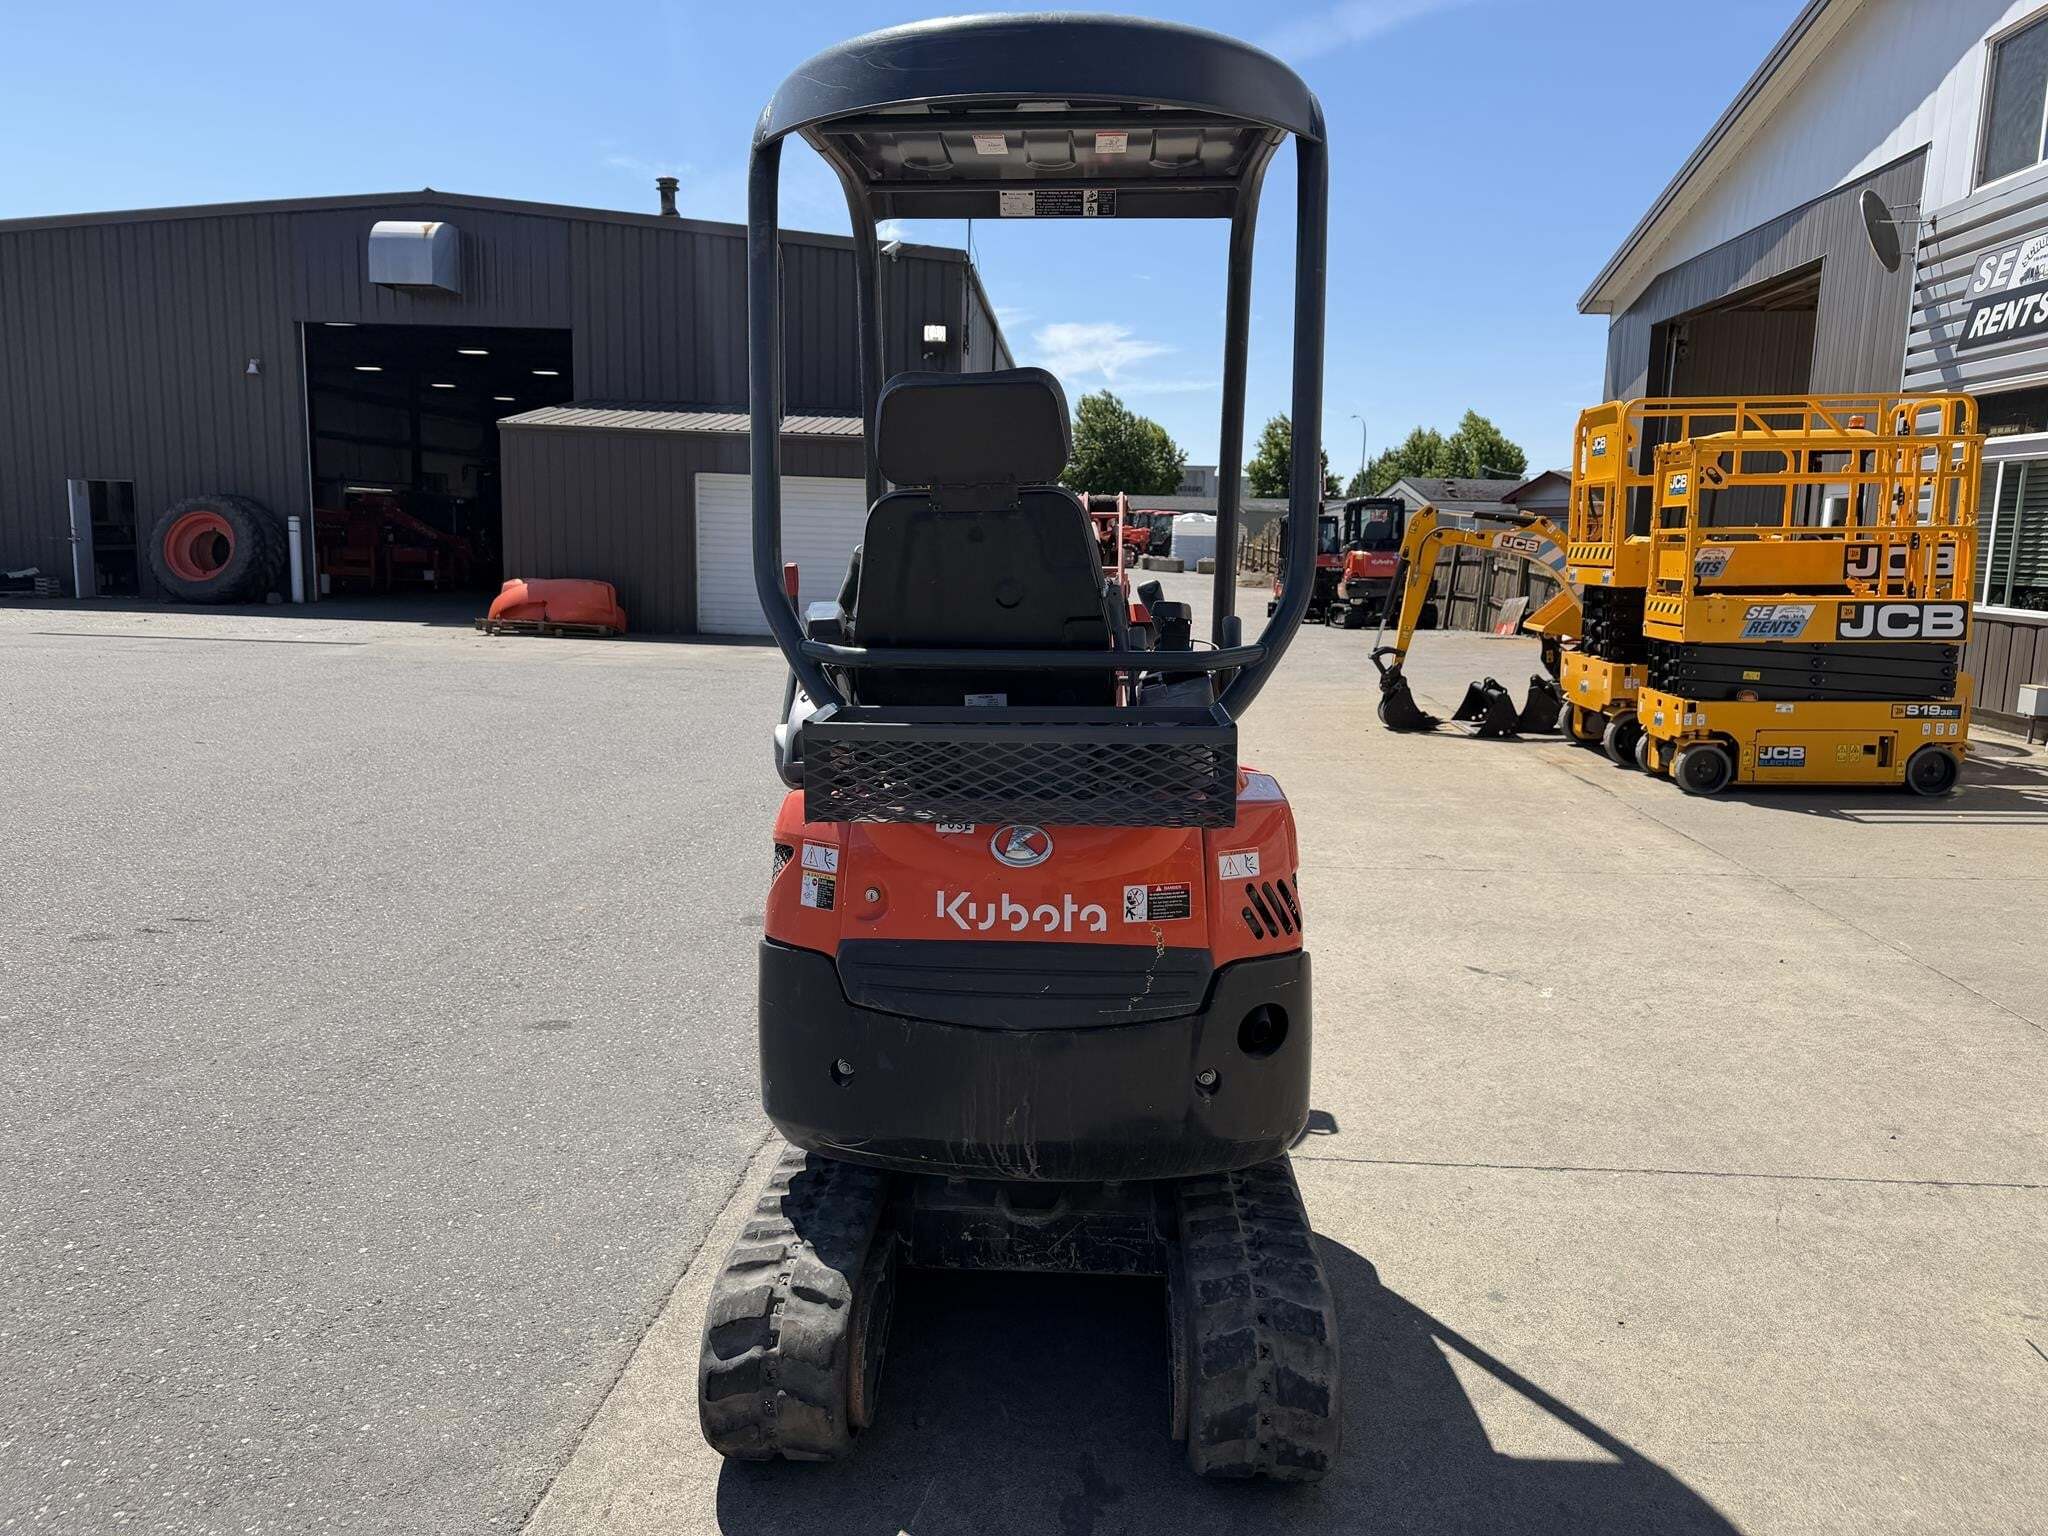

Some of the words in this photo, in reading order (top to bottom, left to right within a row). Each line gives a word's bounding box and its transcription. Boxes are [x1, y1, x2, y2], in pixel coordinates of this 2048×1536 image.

[1973, 249, 2018, 293] SE
[1968, 291, 2048, 340] RENTS
[1592, 436, 1606, 450] JCB
[1669, 474, 1688, 489] JCB
[1502, 537, 1539, 551] JCB
[1746, 606, 1775, 619] SE
[1747, 620, 1801, 634] RENTS
[1839, 604, 1965, 638] JCB
[1759, 746, 1805, 760] JCB
[936, 890, 1107, 932] Kubota
